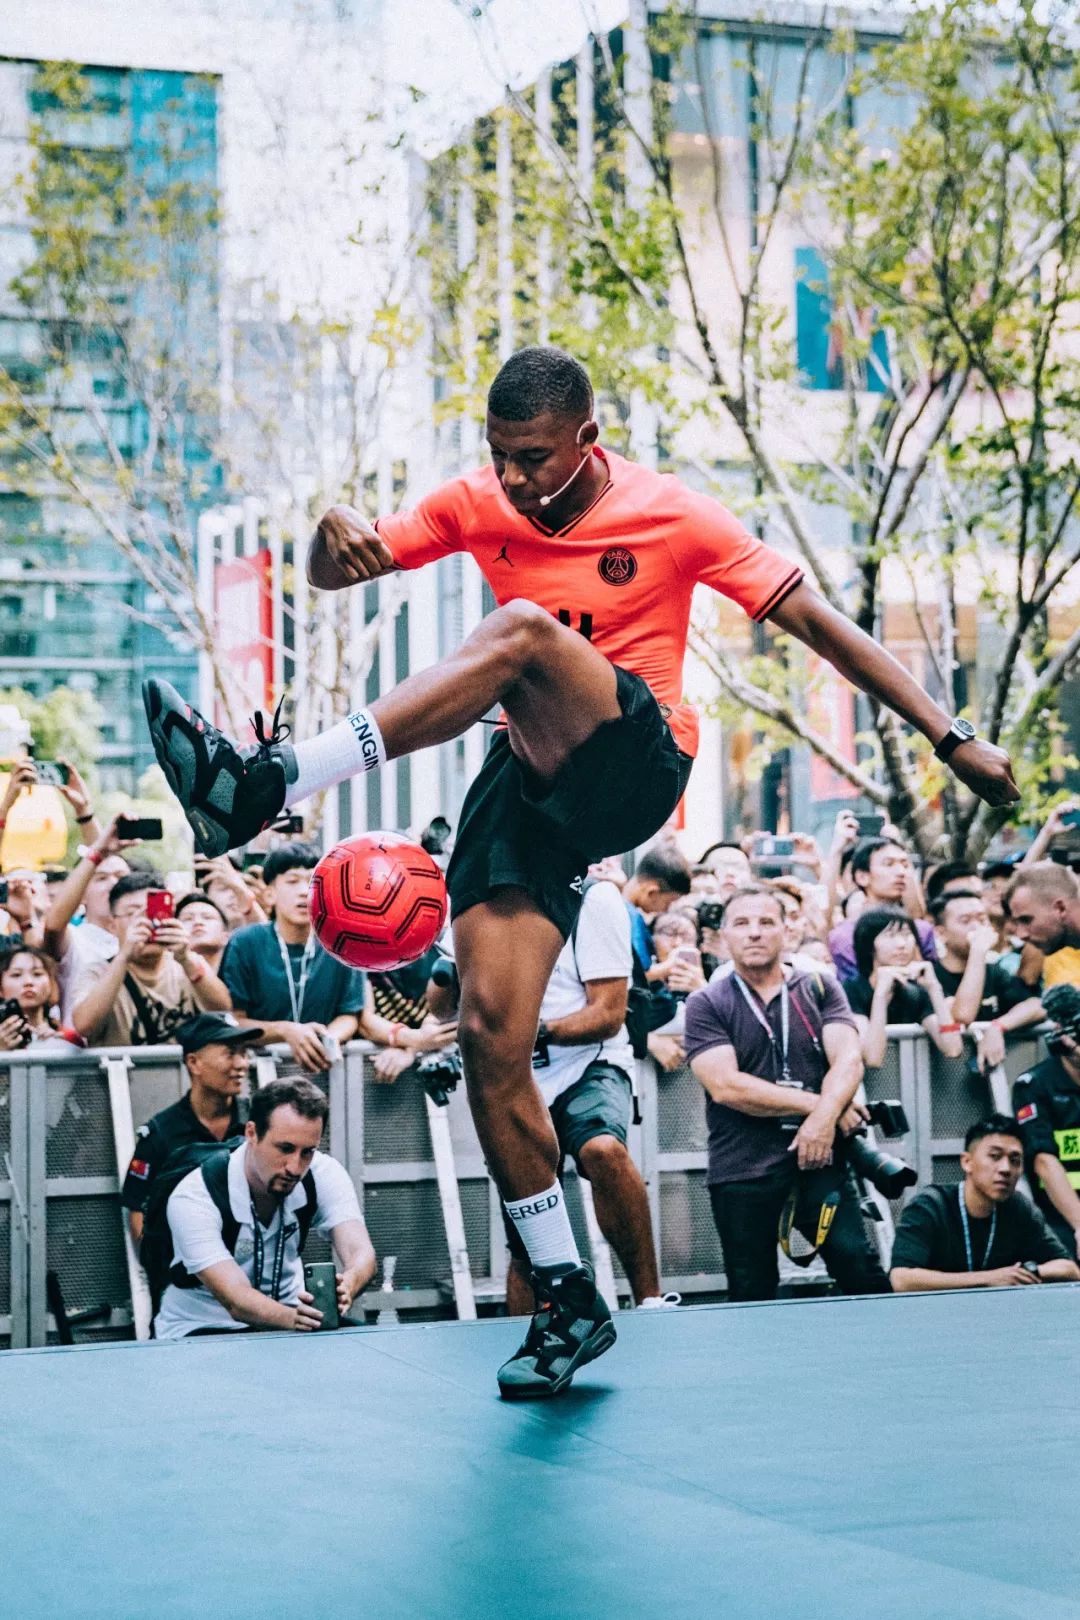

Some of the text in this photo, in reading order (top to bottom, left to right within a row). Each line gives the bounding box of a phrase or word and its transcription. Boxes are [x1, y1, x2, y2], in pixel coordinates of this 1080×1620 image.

[606, 550, 630, 560] PARIS
[348, 712, 379, 771] ENGIN
[509, 1194, 559, 1220] ERED
